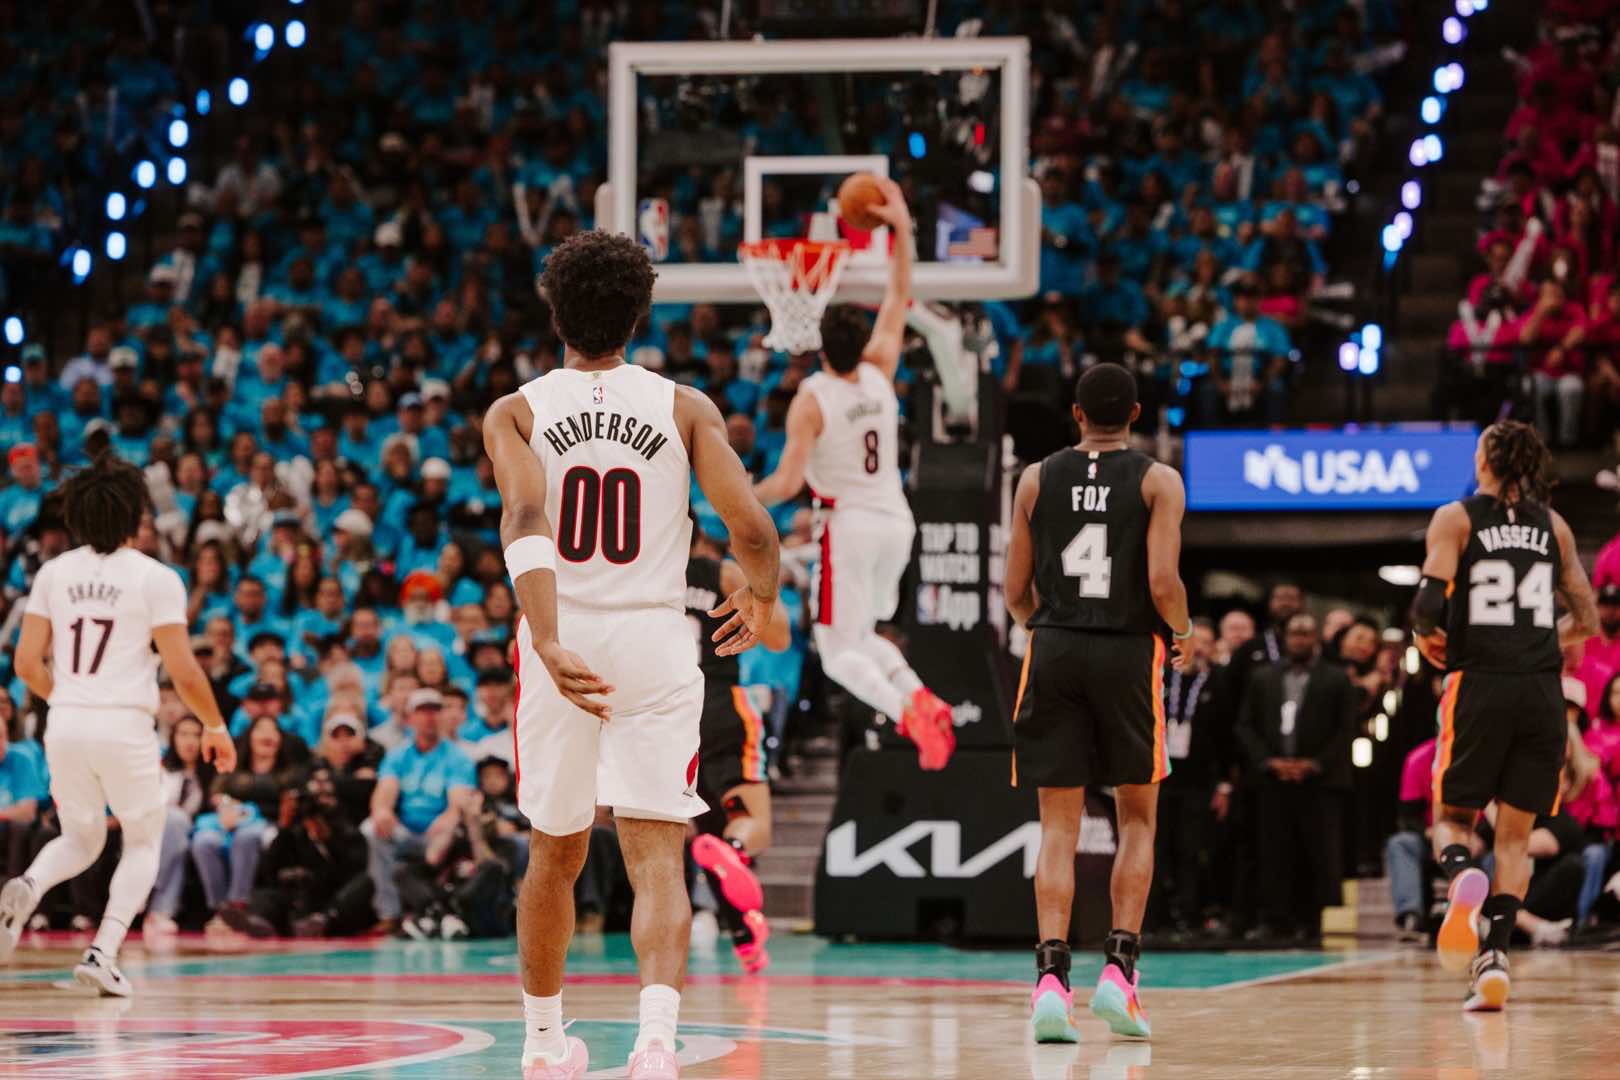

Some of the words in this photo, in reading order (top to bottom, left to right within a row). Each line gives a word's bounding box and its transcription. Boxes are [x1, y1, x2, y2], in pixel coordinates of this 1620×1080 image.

[543, 412, 668, 461] HENDERSON
[865, 430, 879, 475] 8
[1302, 449, 1420, 494] USAA
[557, 465, 641, 565] 00
[1071, 485, 1111, 512] FOX
[1061, 523, 1112, 599] 4
[1477, 524, 1549, 556] VASSELL
[67, 581, 123, 607] SHARPE
[1469, 559, 1554, 629] 24
[69, 616, 115, 675] 17
